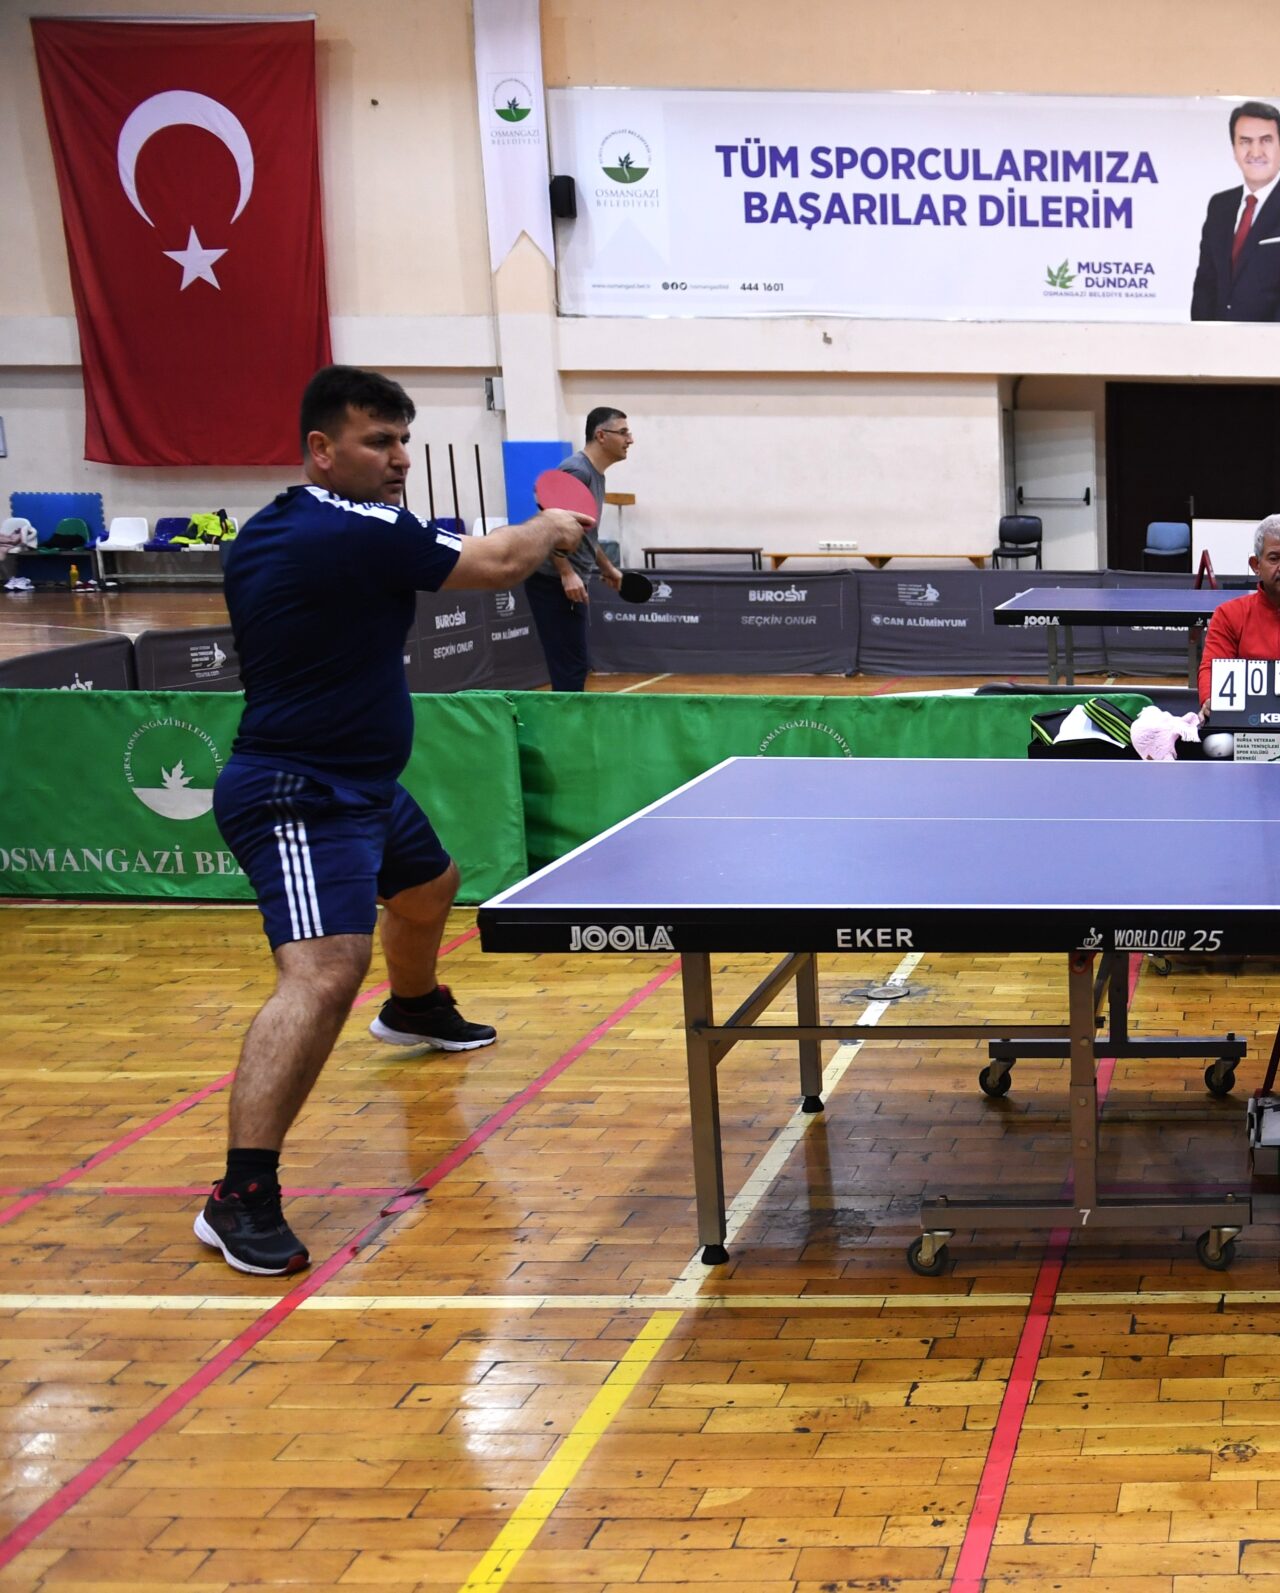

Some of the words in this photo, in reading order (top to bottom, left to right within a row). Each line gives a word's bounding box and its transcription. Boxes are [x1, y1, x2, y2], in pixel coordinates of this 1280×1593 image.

[715, 138, 799, 178] TÜM
[810, 146, 1158, 184] SPORCULARIMIZA
[595, 188, 660, 200] OSMANGAZİ
[743, 192, 968, 231] BAŞARILAR
[979, 187, 1134, 230] DİLERİM
[1077, 261, 1155, 275] MUSTAFA
[740, 283, 759, 292] 444
[763, 283, 785, 292] 1601
[1085, 276, 1149, 289] DÜNDAR
[1043, 290, 1087, 298] OSMANGAZİ
[615, 612, 637, 622] CAN
[638, 612, 700, 624] ALÜMİNYUM
[740, 614, 782, 627] SEÇKİN
[784, 615, 817, 626] ONUR
[883, 616, 904, 626] CAN
[906, 616, 967, 628] ALÜMİNYUM
[1024, 615, 1060, 626] JOOLA
[1218, 670, 1237, 707] 4
[1251, 667, 1264, 694] 0
[759, 719, 809, 752] OSMANGAZİ
[810, 721, 853, 757] BELEDİYE
[569, 925, 675, 951] JOOLA
[836, 928, 914, 948] EKER
[1114, 929, 1158, 947] WORLD
[1161, 929, 1186, 947] CUP
[1189, 930, 1223, 951] 25
[1079, 1208, 1091, 1225] 7
